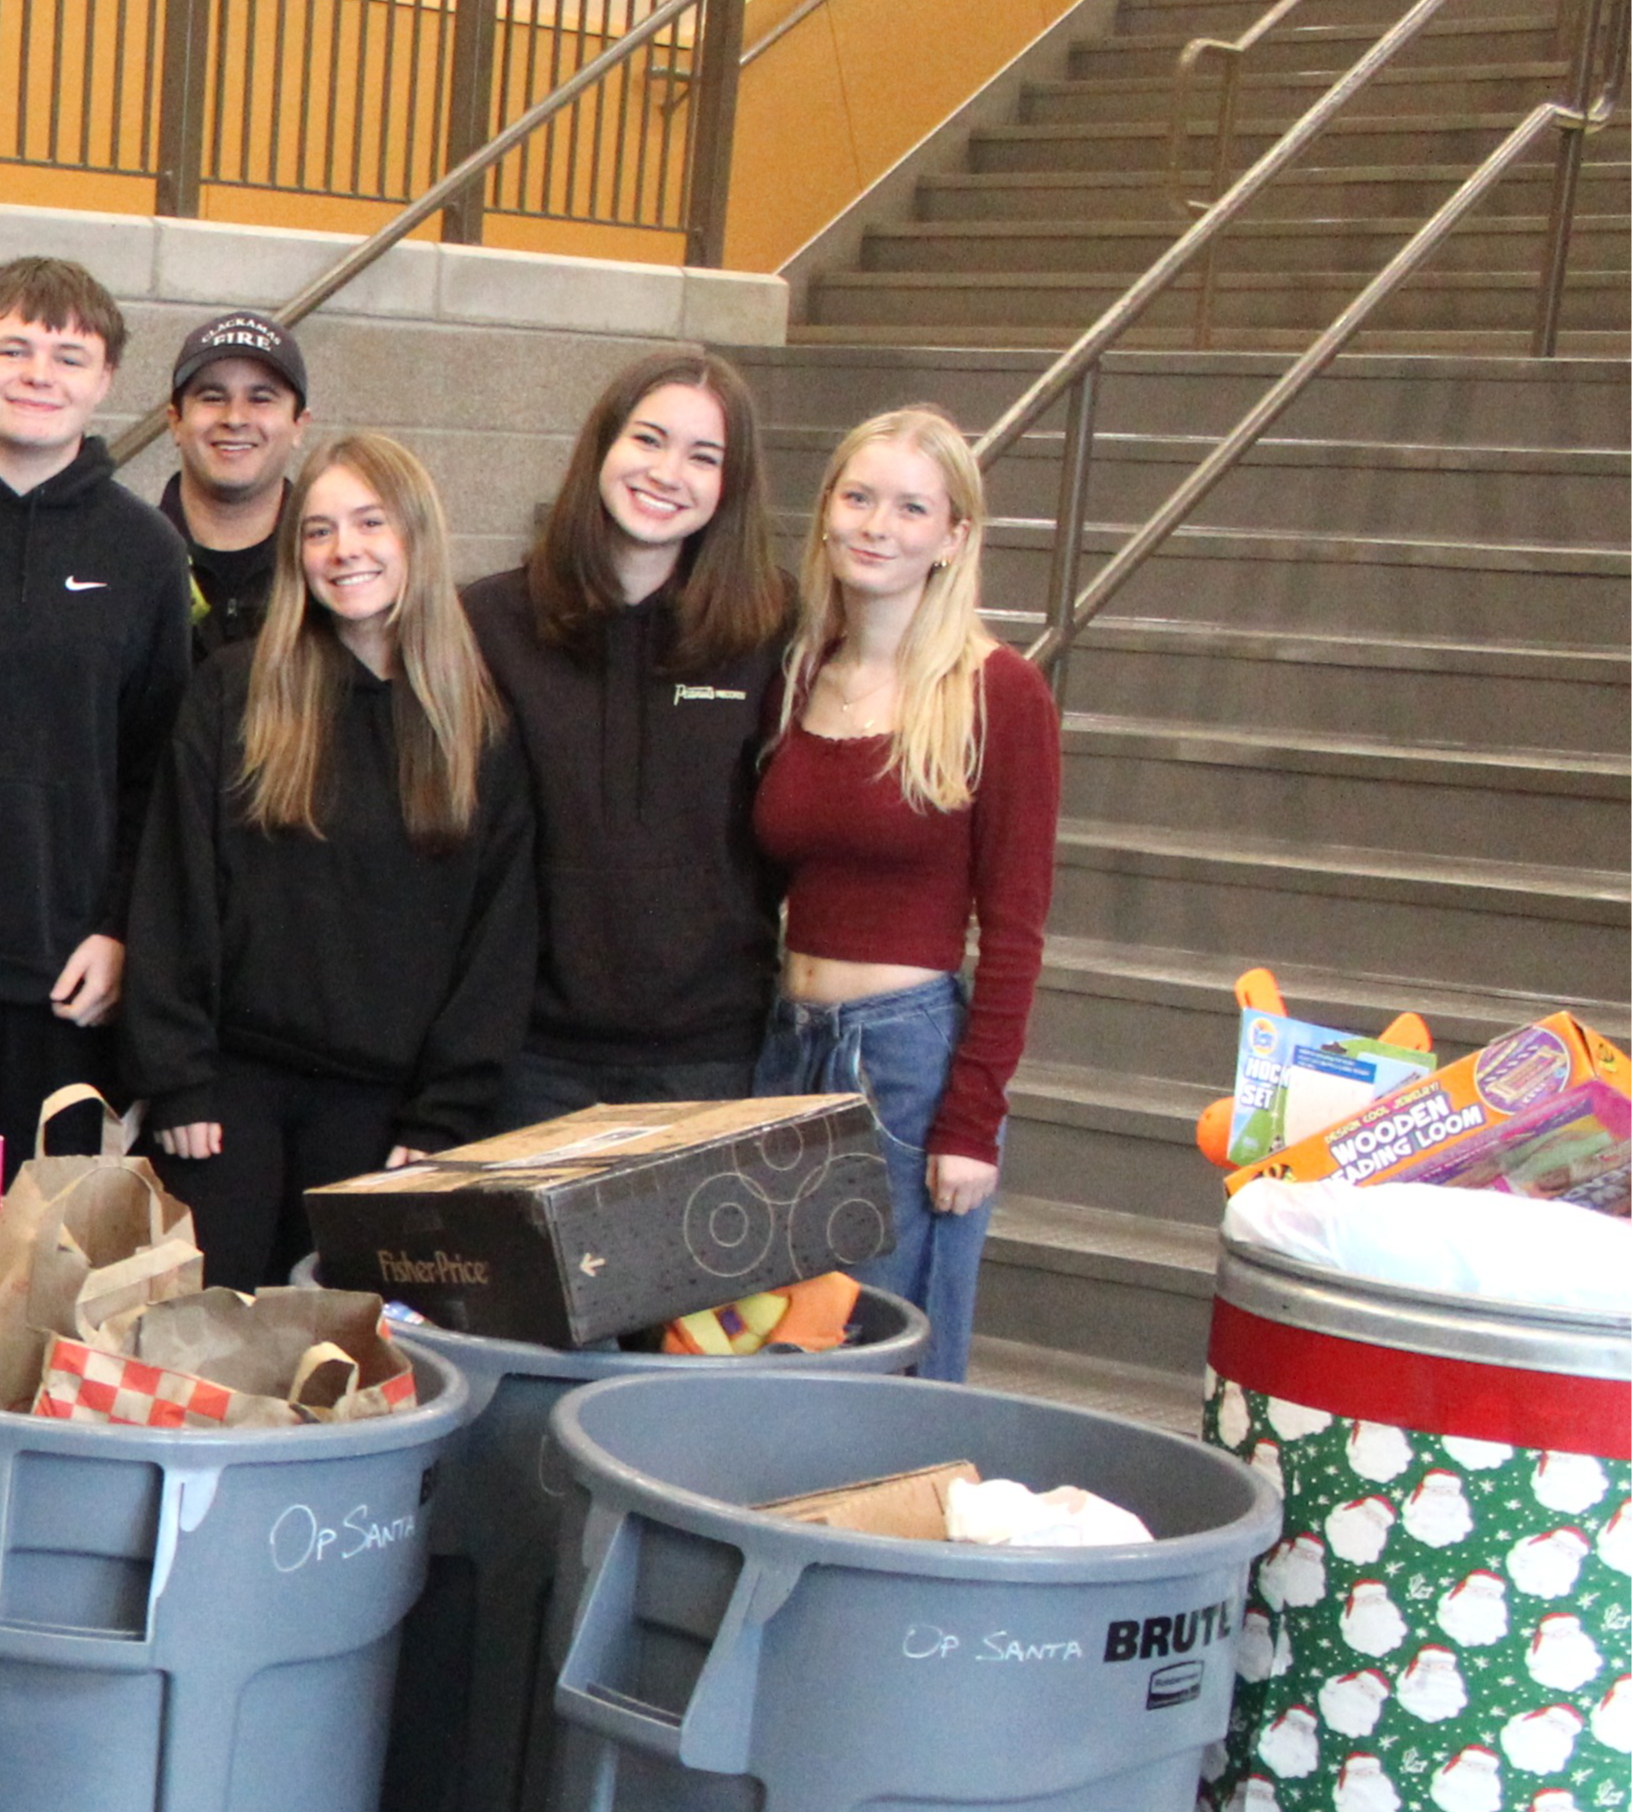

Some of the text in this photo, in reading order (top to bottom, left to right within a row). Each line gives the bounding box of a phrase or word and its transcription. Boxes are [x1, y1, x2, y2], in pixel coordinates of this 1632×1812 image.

[201, 318, 282, 346] CLACKAMAS
[213, 331, 272, 352] FIRE
[1244, 1056, 1291, 1089] HOCK
[1240, 1083, 1275, 1111] SET
[1362, 1105, 1390, 1123] COOL
[1330, 1094, 1450, 1167] WOODEN
[1330, 1136, 1413, 1182] EADING
[1415, 1104, 1484, 1150] LOOM
